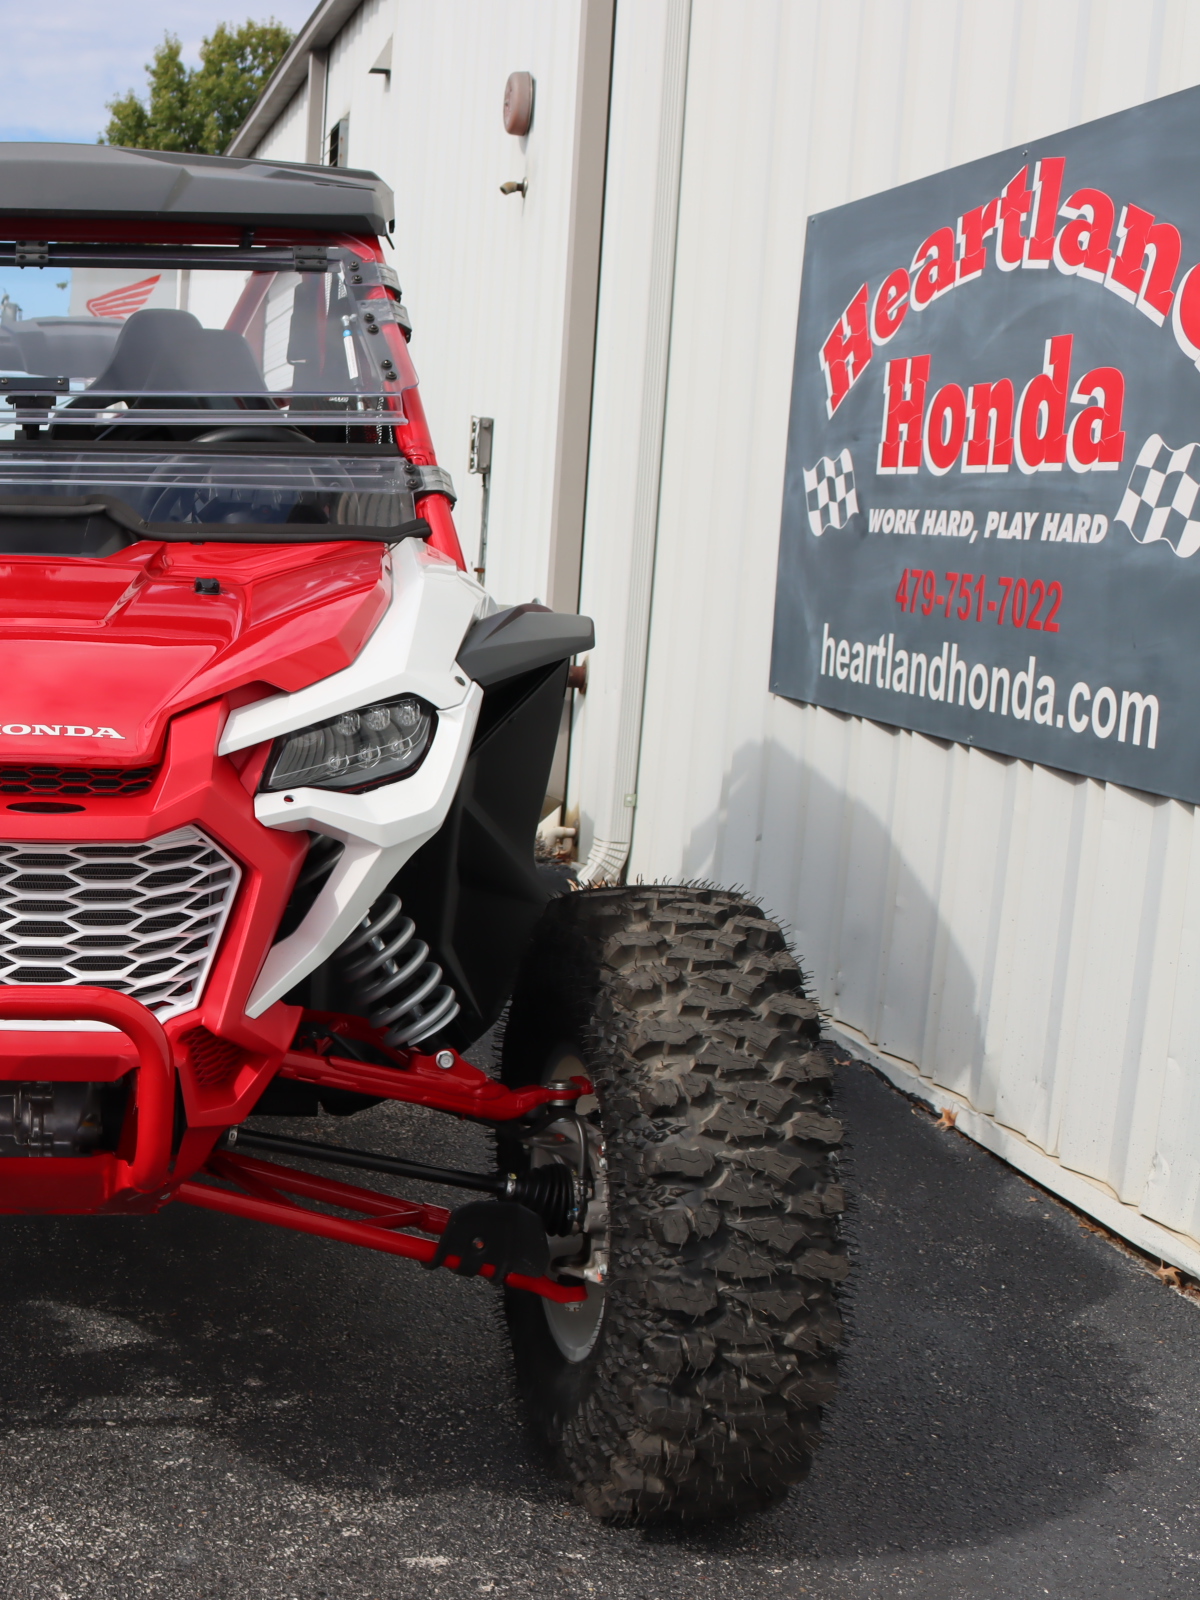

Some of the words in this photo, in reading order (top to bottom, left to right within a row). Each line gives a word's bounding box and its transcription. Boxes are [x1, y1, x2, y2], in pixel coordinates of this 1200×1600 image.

[876, 333, 1126, 476] Honda
[868, 508, 920, 535] WORK
[921, 509, 978, 544] HARD,
[984, 511, 1040, 540] PLAY
[1040, 512, 1109, 544] HARD
[895, 567, 1063, 633] 479-751-7022
[820, 622, 1160, 750] heartlandhonda.com
